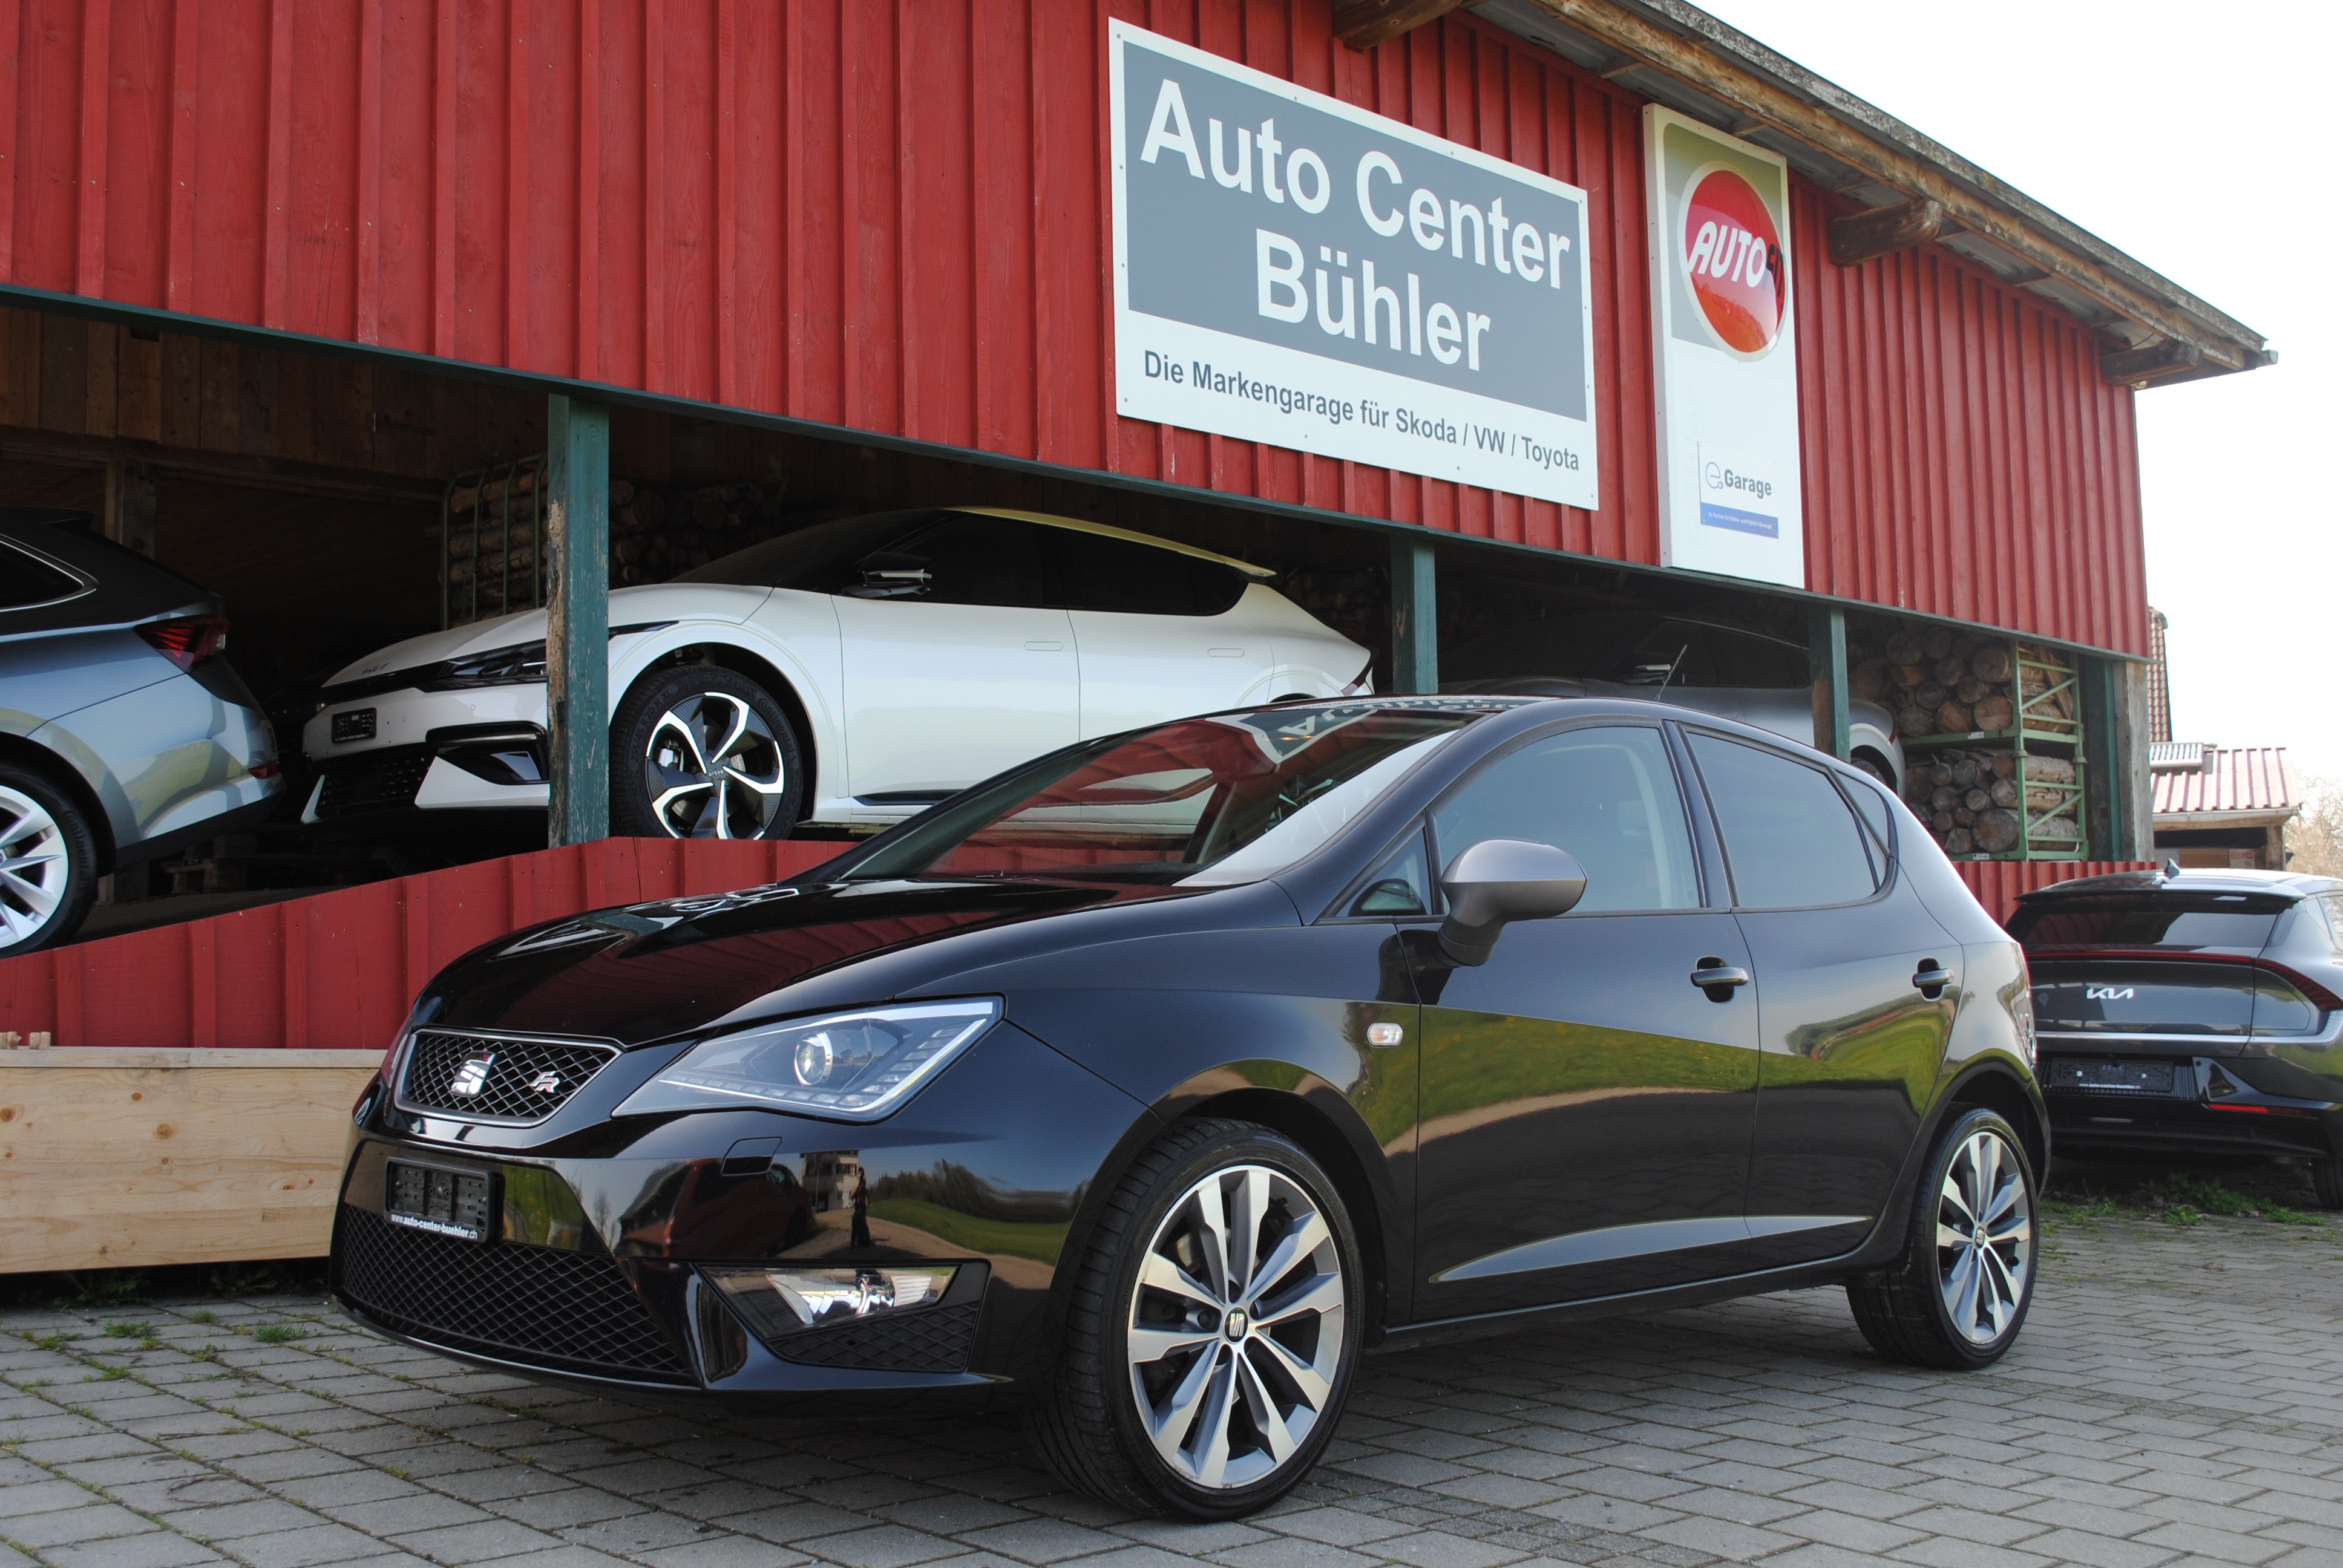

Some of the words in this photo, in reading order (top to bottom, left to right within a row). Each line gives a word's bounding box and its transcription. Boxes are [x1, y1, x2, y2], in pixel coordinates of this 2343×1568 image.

[1141, 79, 1331, 214] Auto
[1357, 151, 1571, 289] Center
[1257, 229, 1490, 371] Bühler
[1145, 350, 1184, 384] Die
[1193, 361, 1354, 425] Markengarage
[1360, 399, 1389, 428] für
[1395, 408, 1457, 444] Skoda
[1463, 423, 1468, 446] /
[1473, 425, 1505, 454] VW
[1511, 434, 1516, 457] /
[1521, 436, 1579, 471] Toyota
[1724, 469, 1772, 499] Garage
[758, 697, 795, 753] Continental
[63, 809, 90, 881] Continental
[2086, 987, 2134, 999] KIA
[529, 1071, 560, 1093] FR
[391, 1214, 477, 1240] www.auto-center-buehler.ch
